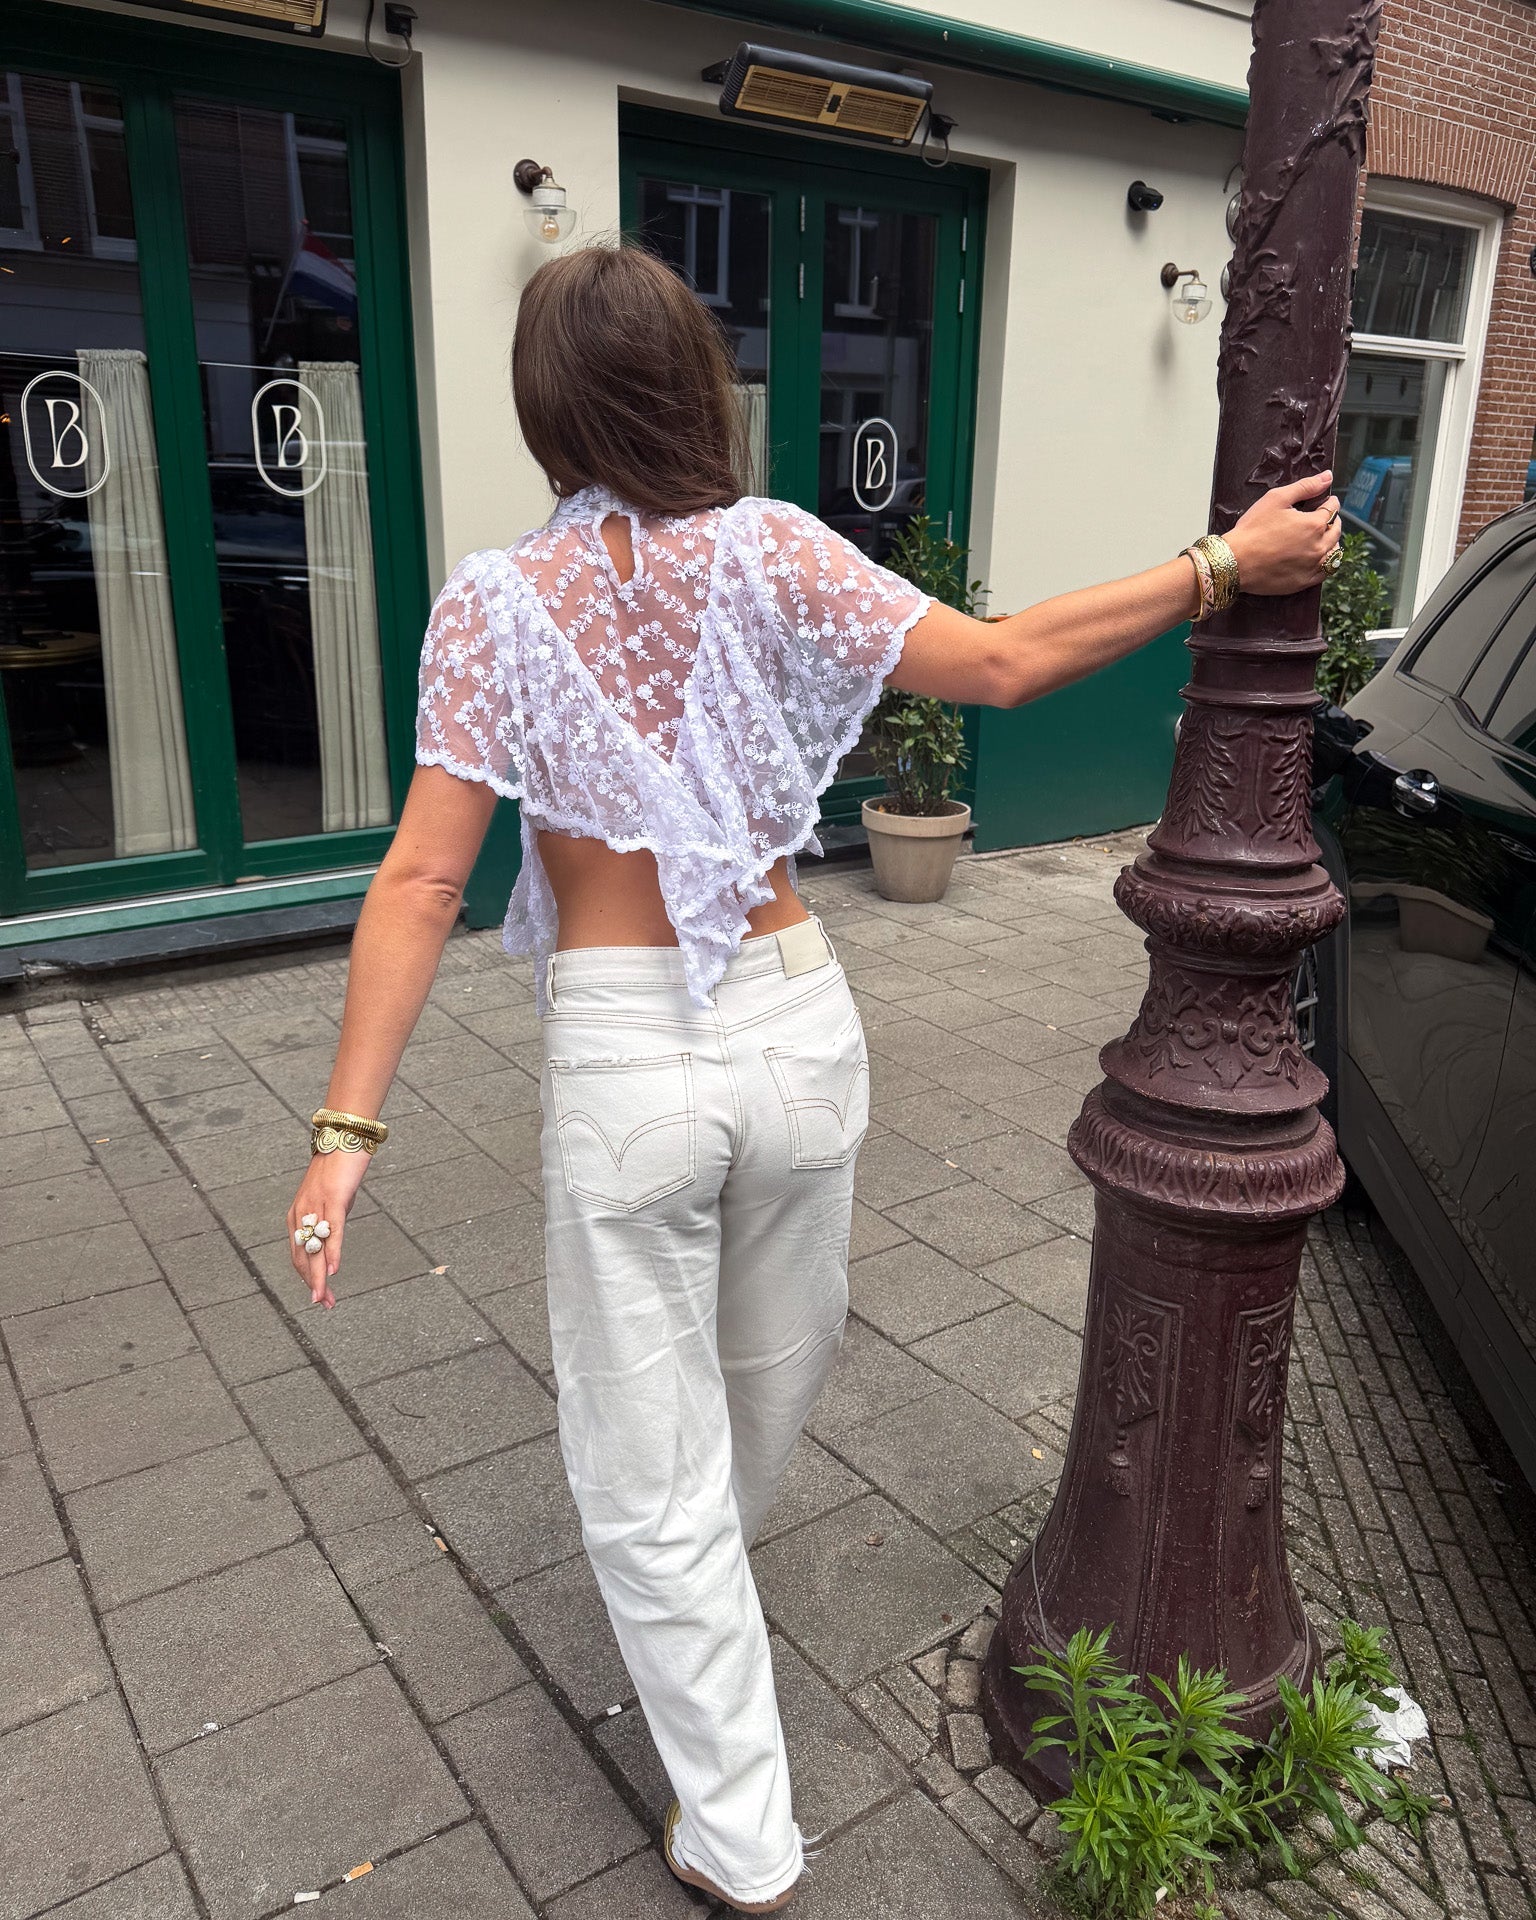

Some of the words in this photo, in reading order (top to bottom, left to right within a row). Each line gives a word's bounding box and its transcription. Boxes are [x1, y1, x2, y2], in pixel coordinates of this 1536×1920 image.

[45, 399, 89, 468] B
[271, 405, 309, 468] B
[865, 439, 887, 490] B
